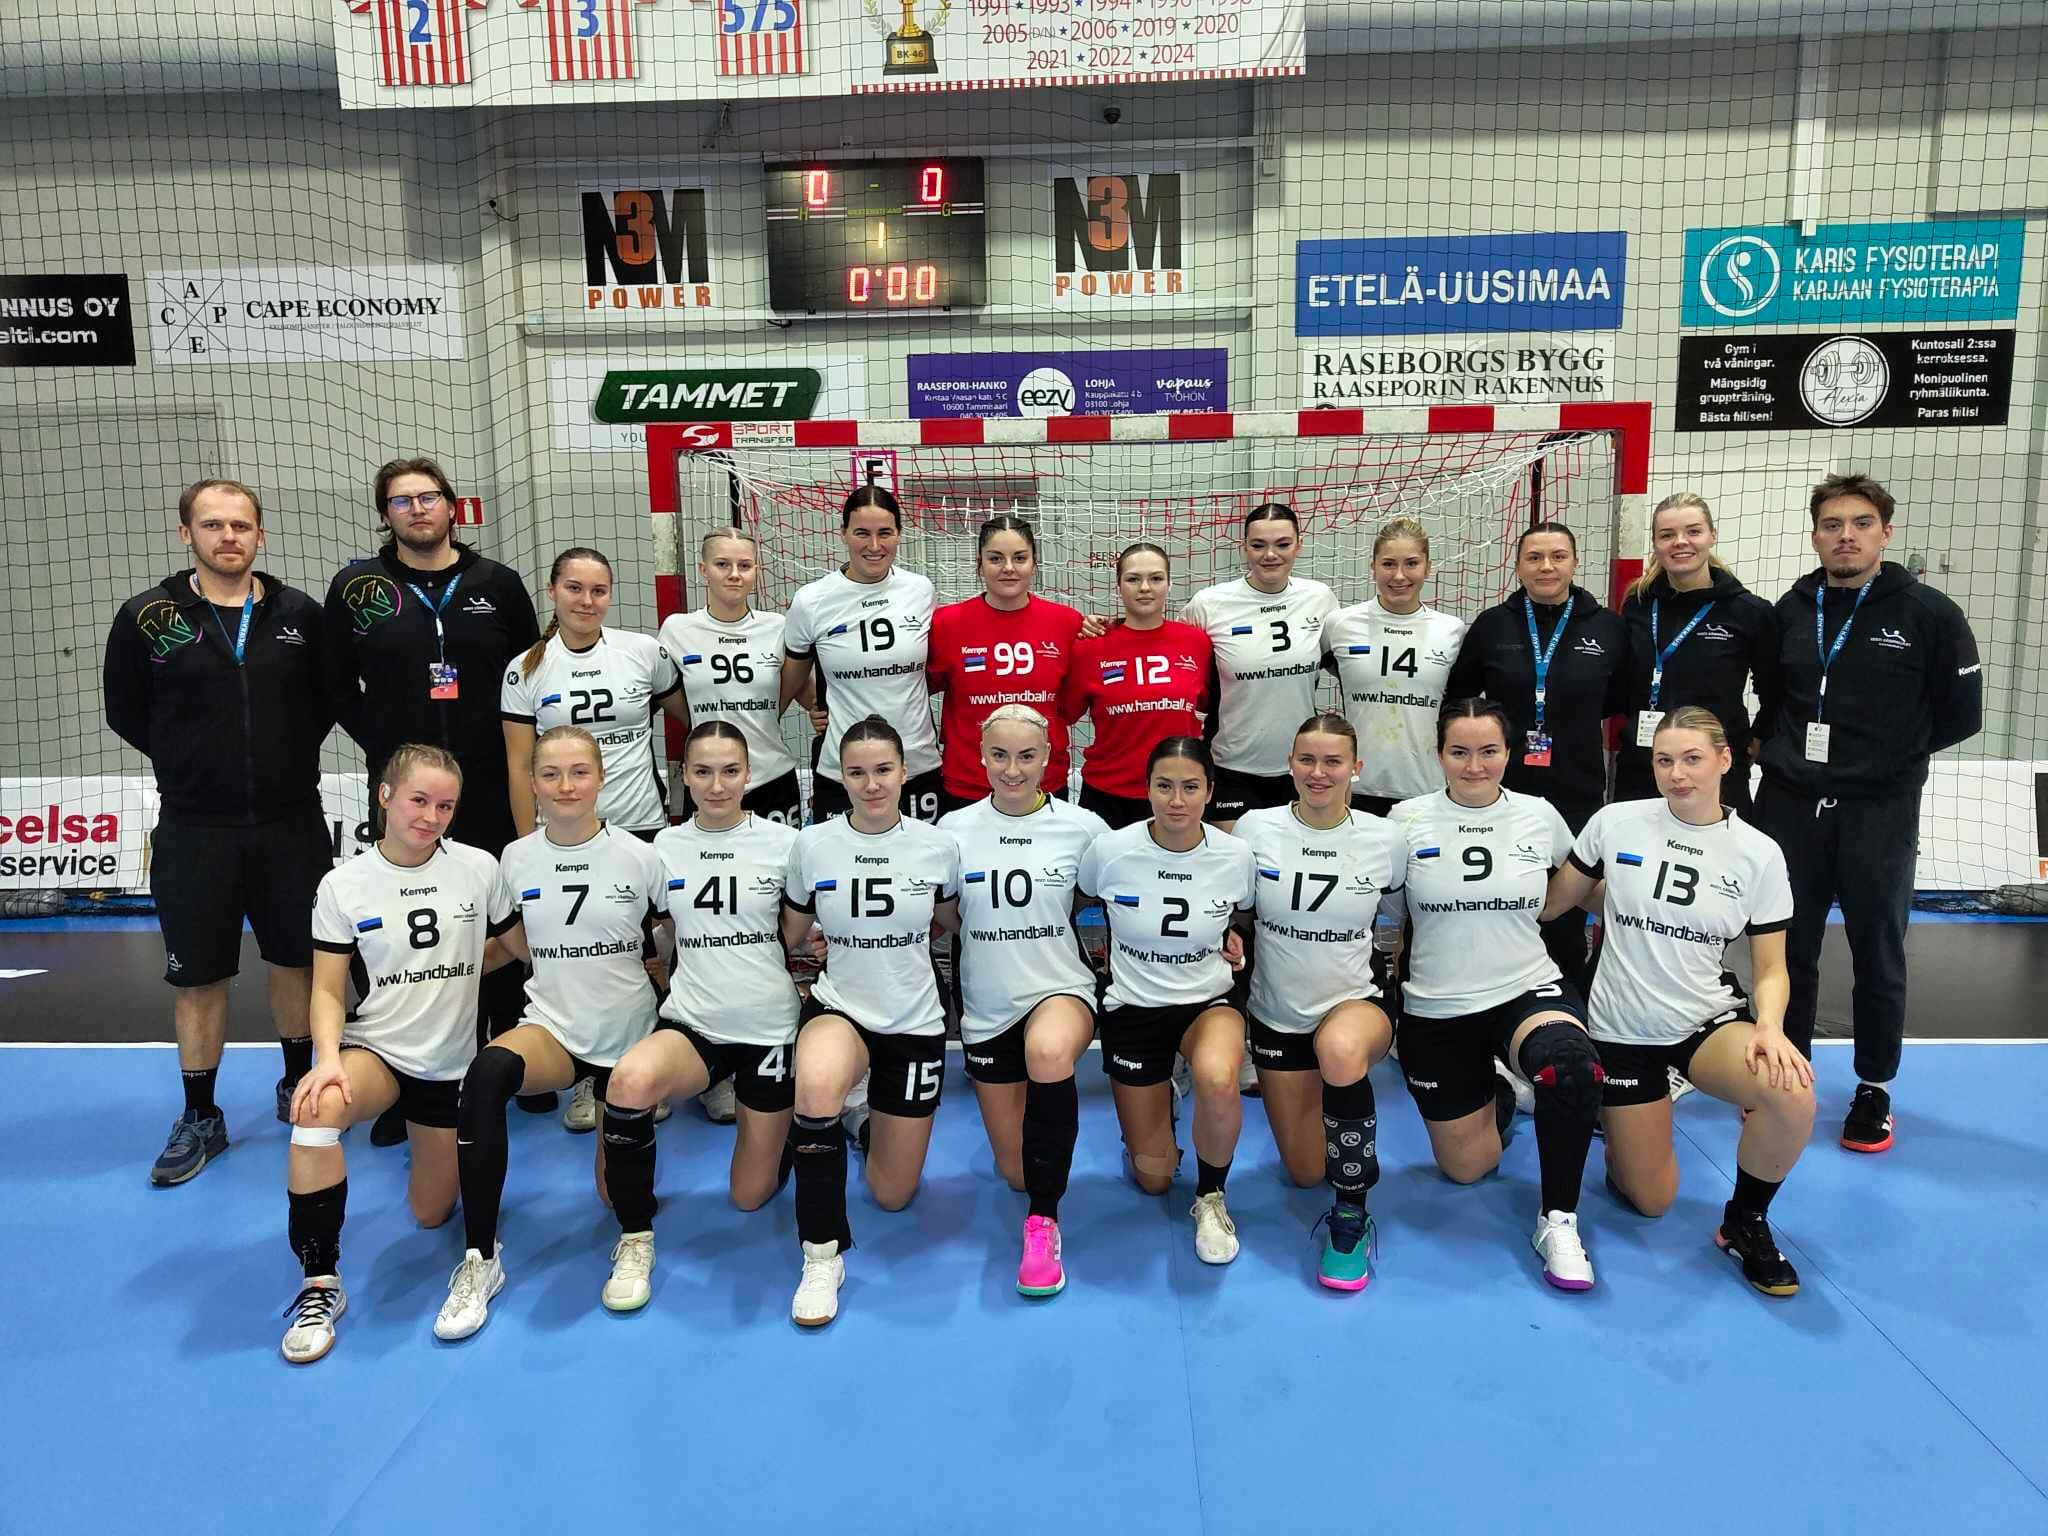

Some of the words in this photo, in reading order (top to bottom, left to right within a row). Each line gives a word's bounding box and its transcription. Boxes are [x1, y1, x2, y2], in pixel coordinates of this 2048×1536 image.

[970, 0, 1009, 16] 1991
[408, 0, 432, 43] 2
[577, 0, 600, 38] 3
[982, 24, 1029, 44] 2005
[1071, 19, 1118, 42] 2006
[1132, 17, 1176, 38] 2019
[1194, 14, 1239, 35] 2020
[896, 49, 924, 60] BK-46
[1027, 50, 1069, 70] 2021
[1088, 46, 1133, 67] 2022
[1151, 44, 1195, 64] 2024
[922, 167, 944, 201] 0
[1794, 247, 1856, 276] KARIS
[1866, 243, 1999, 274] FYSIOTERAPI
[183, 282, 200, 299] A
[1056, 272, 1183, 297] POWER
[1308, 265, 1611, 307] ETELÄ-UUSIMAA
[1792, 279, 1872, 303] KARJAAN
[1879, 275, 2000, 299] FYSIOTERAPIA
[588, 285, 713, 310] POWER
[83, 298, 119, 319] OY
[160, 307, 177, 326] C
[212, 306, 228, 325] P
[246, 299, 311, 319] CAPE
[317, 297, 442, 318] ECONOMY
[189, 337, 206, 355] E
[1724, 343, 1750, 357] Gym
[1911, 337, 1965, 351] Kuntosali
[1966, 337, 1997, 349] 2:ssa
[1313, 350, 1507, 378] RASEBORGS
[1517, 347, 1605, 374] BYGG
[1703, 357, 1722, 370] två
[1724, 356, 1776, 371] våningar.
[1916, 352, 1989, 365] kerroksessa.
[917, 381, 1008, 392] RAASEPORI-HANKO
[1085, 379, 1116, 390] LOHJA
[1156, 377, 1214, 394] vapaus
[1314, 377, 1465, 400] RAASEPORIN
[1474, 375, 1605, 397] RAKENNUS
[1710, 375, 1767, 391] Mångsidig
[1913, 371, 1988, 387] Monipuolinen
[620, 380, 798, 410] TAMMET
[1021, 388, 1073, 412] eezy
[1699, 390, 1776, 405] gruppträning.
[1909, 386, 1990, 401] ryhmäliikunta.
[1699, 409, 1732, 423] Bästa
[1917, 406, 1946, 419] Paras
[732, 423, 793, 436] SPORT
[732, 435, 793, 445] TRANSFER
[866, 460, 883, 488] F
[861, 598, 890, 609] Kempa
[1260, 604, 1287, 614] Kempa
[859, 617, 896, 652] 19
[1269, 620, 1292, 653] 3
[1384, 626, 1413, 637] Kempa
[718, 636, 747, 646] Kempa
[961, 646, 988, 656] Kempa
[993, 641, 1034, 676] 99
[710, 653, 755, 685] 96
[1100, 659, 1128, 670] Kempa
[1135, 655, 1172, 686] 12
[1380, 645, 1419, 679] 14
[571, 669, 601, 681] Kempa
[569, 688, 617, 725] 22
[910, 792, 938, 824] 19
[1216, 799, 1244, 810] Kempa
[1458, 824, 1494, 836] Kempa
[999, 835, 1033, 847] Kempa
[1666, 838, 1704, 857] Kempa
[700, 850, 735, 862] Kempa
[854, 854, 890, 866] Kempa
[1302, 846, 1337, 860] Kempa
[0, 849, 117, 877] service
[555, 863, 589, 874] Kempa
[1461, 845, 1495, 883] 9
[1157, 869, 1193, 883] Kempa
[1652, 859, 1701, 907] 13
[399, 886, 438, 899] Kempa
[693, 875, 738, 916] 41
[990, 868, 1033, 909] 10
[1290, 871, 1339, 913] 17
[562, 884, 590, 926] 7
[850, 877, 896, 919] 15
[1160, 896, 1190, 938] 2
[407, 907, 441, 950] 8
[1112, 1053, 1143, 1071] Kempa
[904, 1058, 943, 1102] 15
[1408, 1075, 1438, 1089] Kempa
[1602, 1074, 1639, 1088] Kempa
